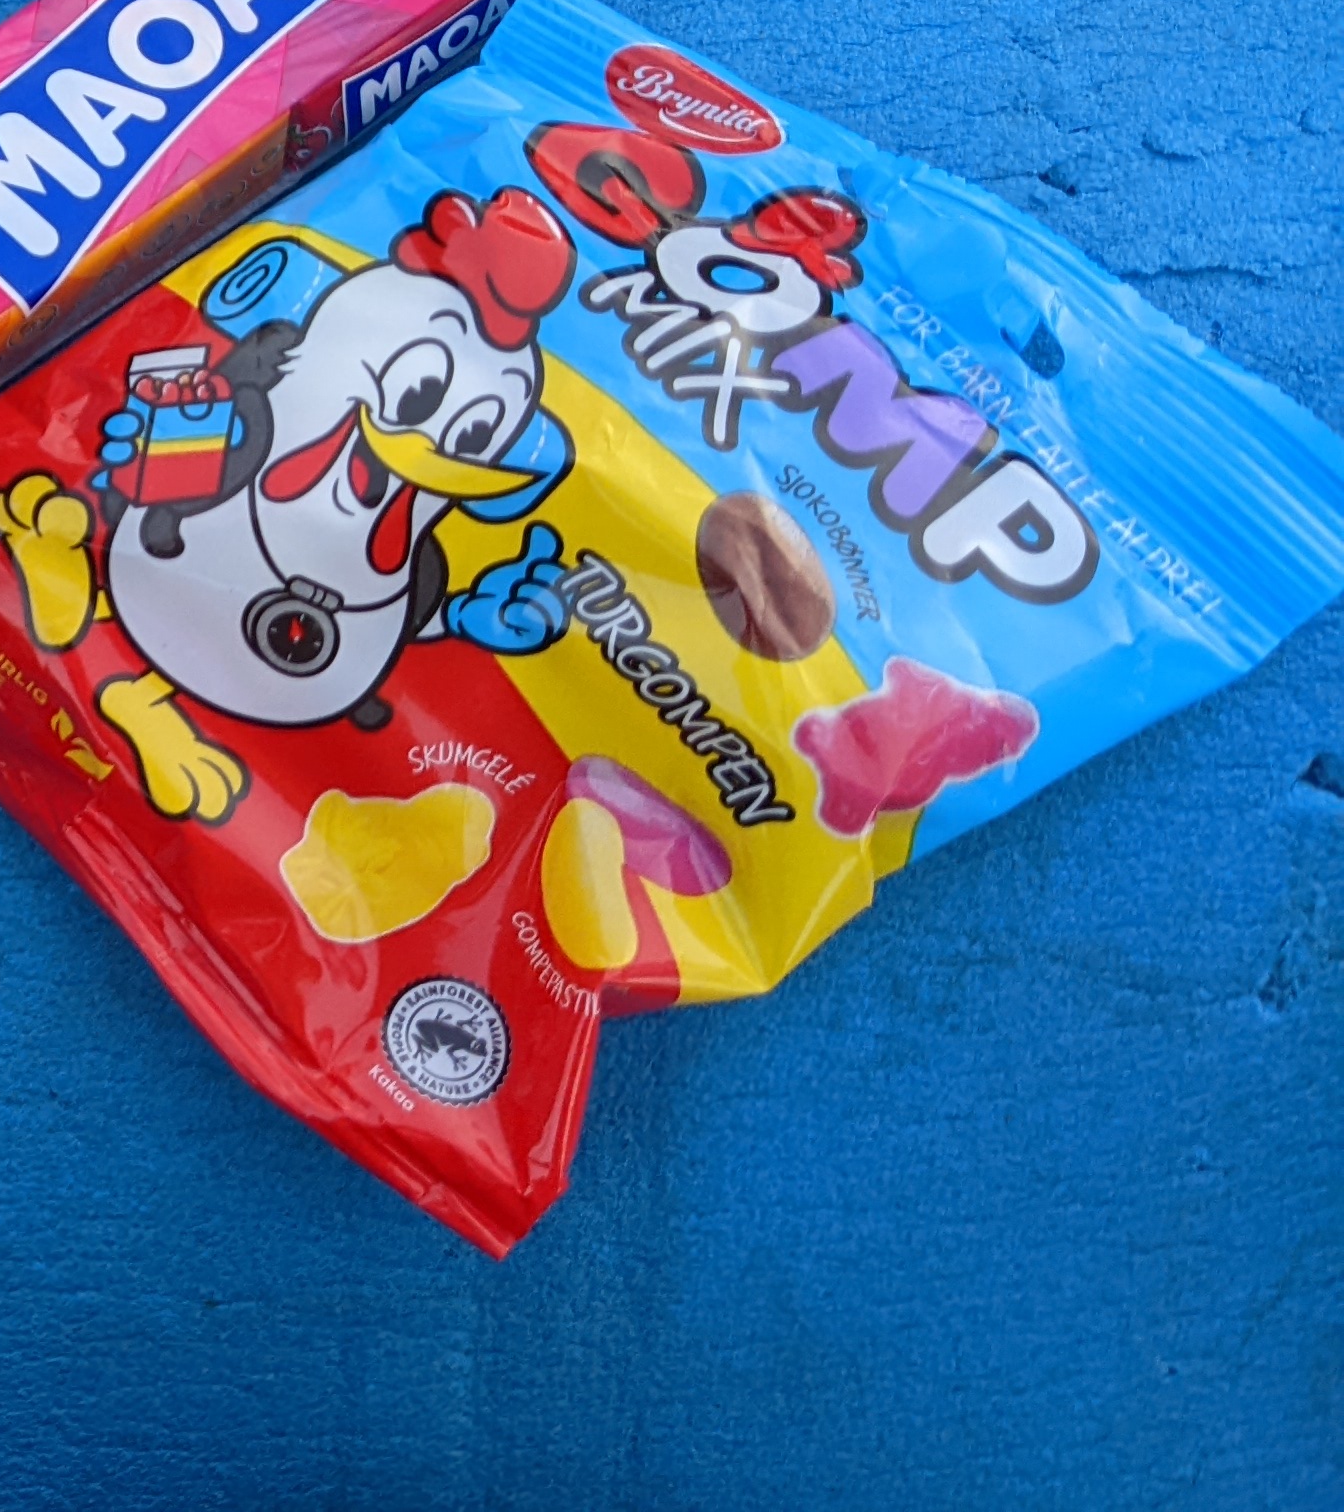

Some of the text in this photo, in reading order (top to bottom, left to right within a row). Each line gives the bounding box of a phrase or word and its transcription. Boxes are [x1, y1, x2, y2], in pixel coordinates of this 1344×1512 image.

[585, 266, 798, 450] MIX
[876, 285, 942, 349] FOR
[936, 345, 1021, 425] BARN
[772, 462, 882, 625] SJOKOBØNNER
[557, 548, 796, 828] TURGOMPEN
[406, 740, 537, 796] SKUMGELÉ
[391, 1012, 411, 1064] PEOPLE
[418, 1074, 472, 1096] NATURE
[406, 984, 503, 1087] RAINFOREST ALLIANCE
